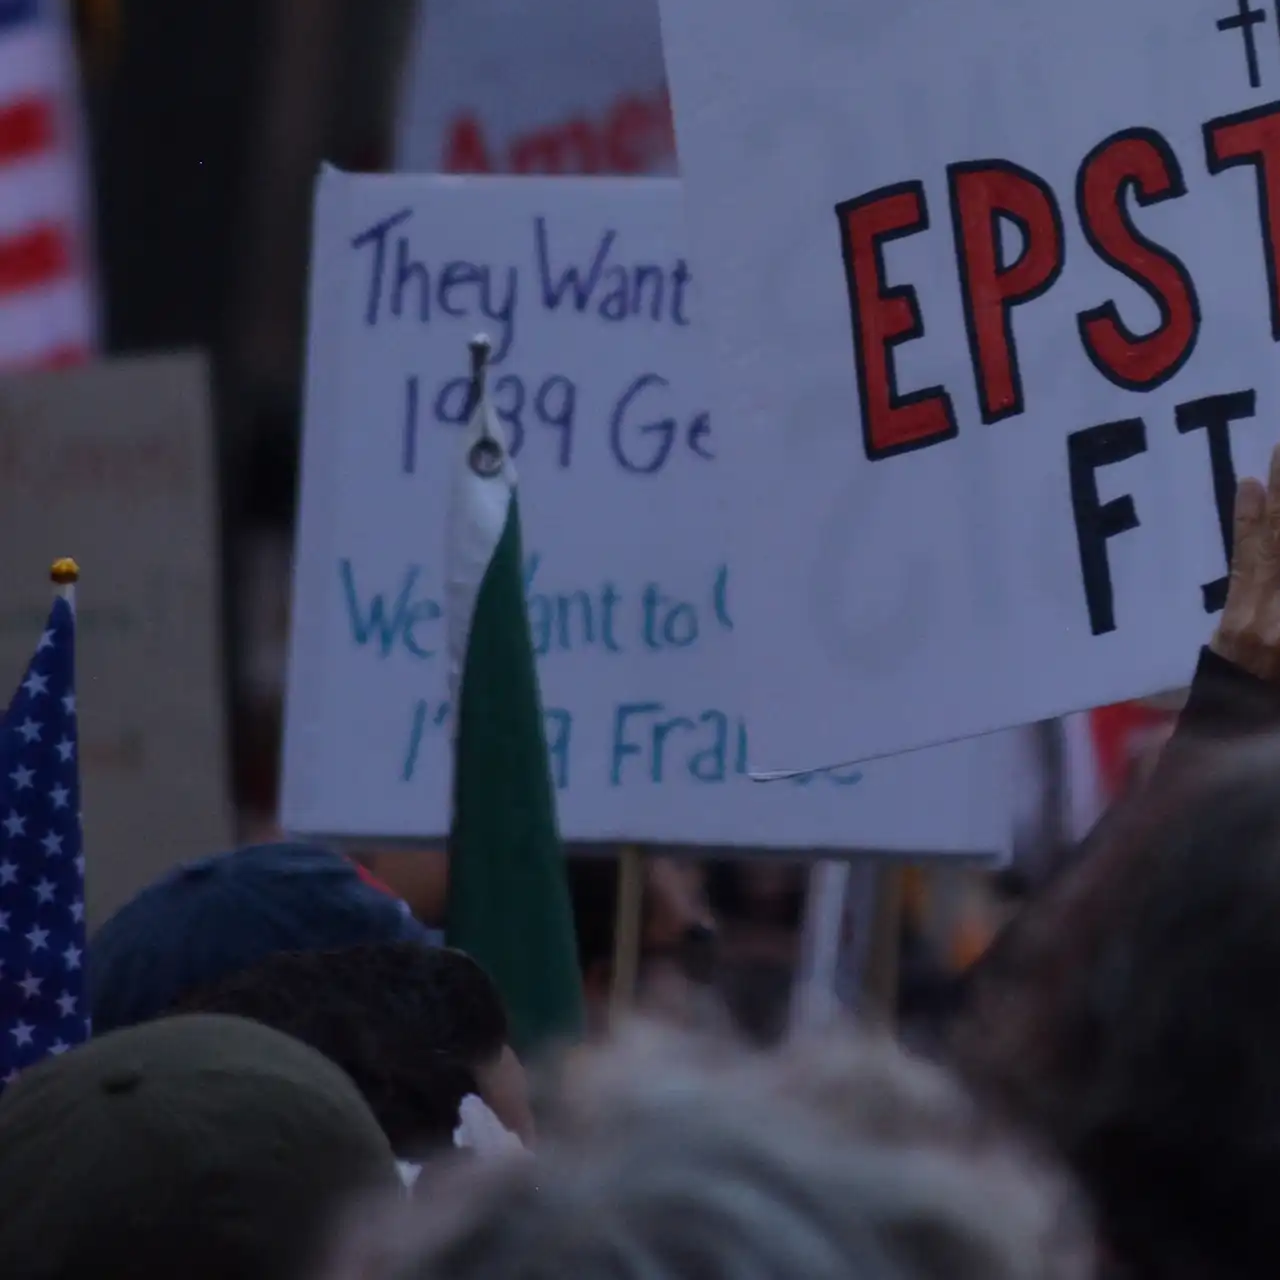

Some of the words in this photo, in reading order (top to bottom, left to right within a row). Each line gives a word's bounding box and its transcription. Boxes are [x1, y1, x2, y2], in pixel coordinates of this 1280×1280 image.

[351, 209, 516, 365] They
[533, 216, 691, 326] Want
[339, 557, 441, 658] We
[525, 552, 620, 655] ant
[642, 582, 700, 649] to
